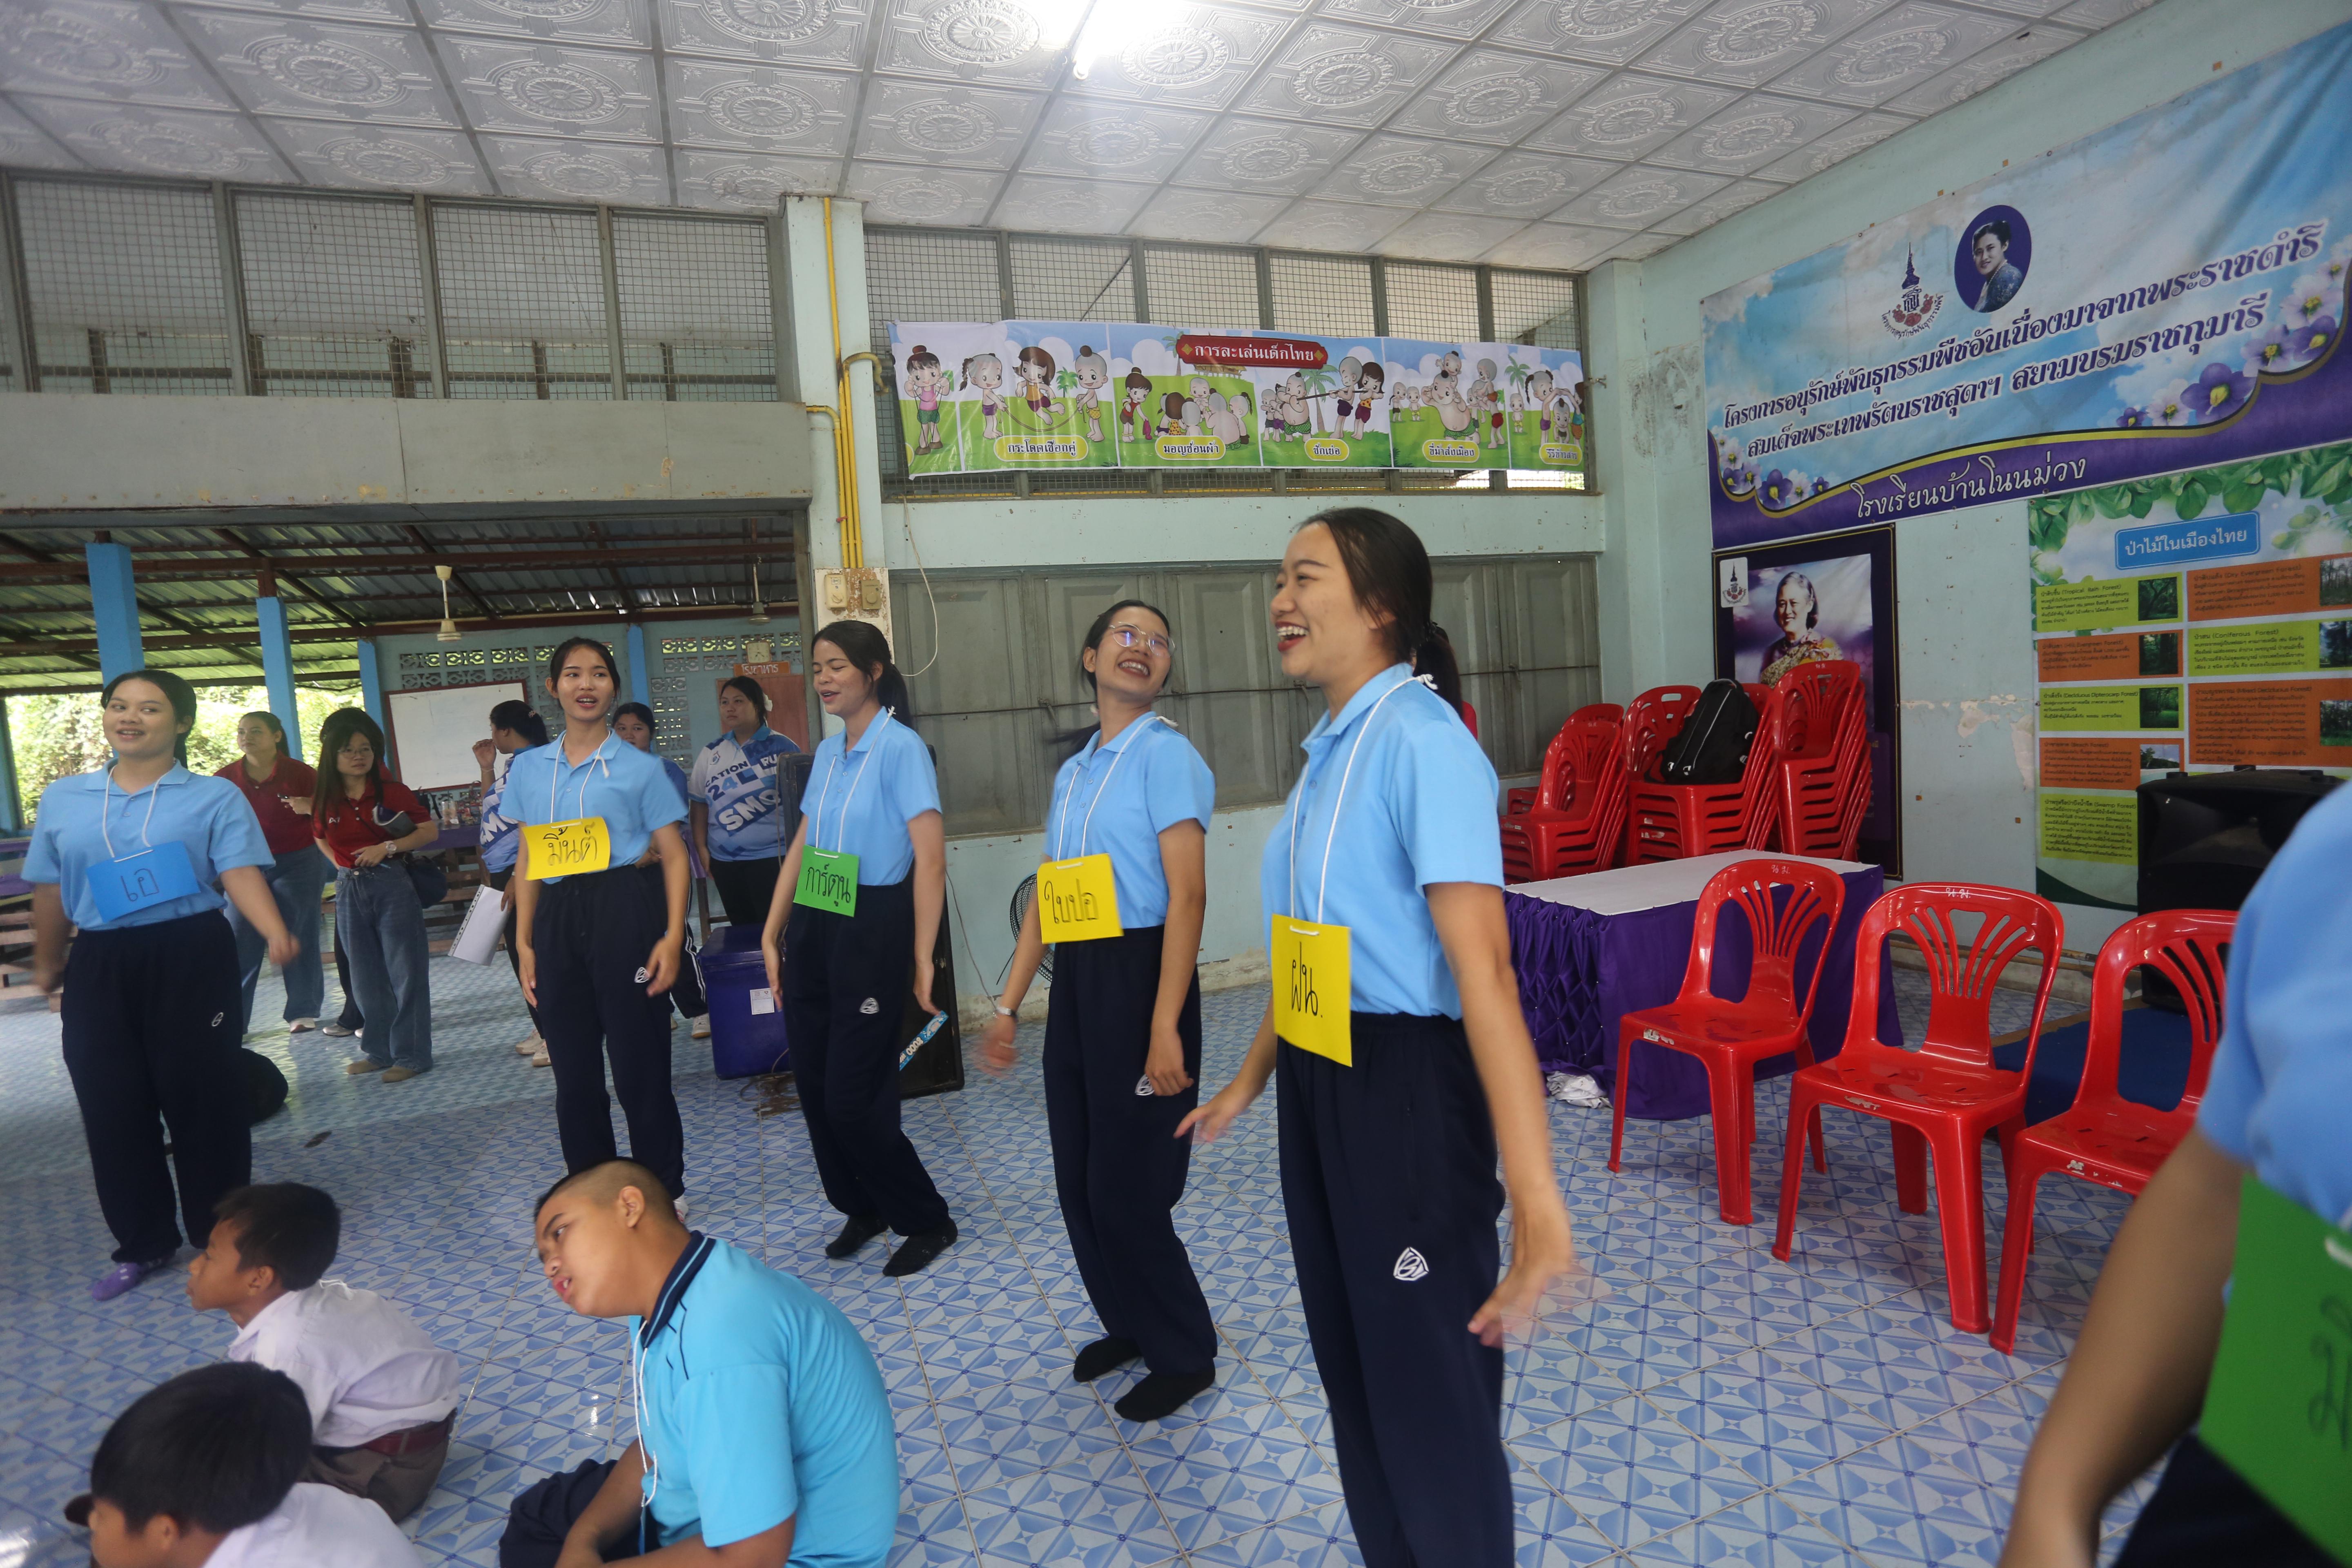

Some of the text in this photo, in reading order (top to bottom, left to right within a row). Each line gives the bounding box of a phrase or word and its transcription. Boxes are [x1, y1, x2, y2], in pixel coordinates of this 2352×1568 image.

[1194, 343, 1314, 361] การละเล่นเด็กไทย
[2011, 292, 2269, 391] สยามบรมราชกุมารี
[1008, 439, 1076, 456] กระโดดเชือกคู่
[1163, 440, 1219, 455] มอญซ่อนผ้า
[1313, 443, 1340, 455] ชักเย่อ
[1850, 450, 2087, 519] โรงเรียนบ้านโนนม่วง
[2125, 527, 2247, 556] ป่าไม้ในเมืองไทย
[741, 664, 778, 675] โรงอาหาร
[708, 776, 738, 801] 24
[543, 822, 598, 866] มิ้นต์
[120, 868, 159, 902] เอ
[806, 863, 851, 907] การ์ตูน
[1044, 878, 1099, 924] ใบปอ
